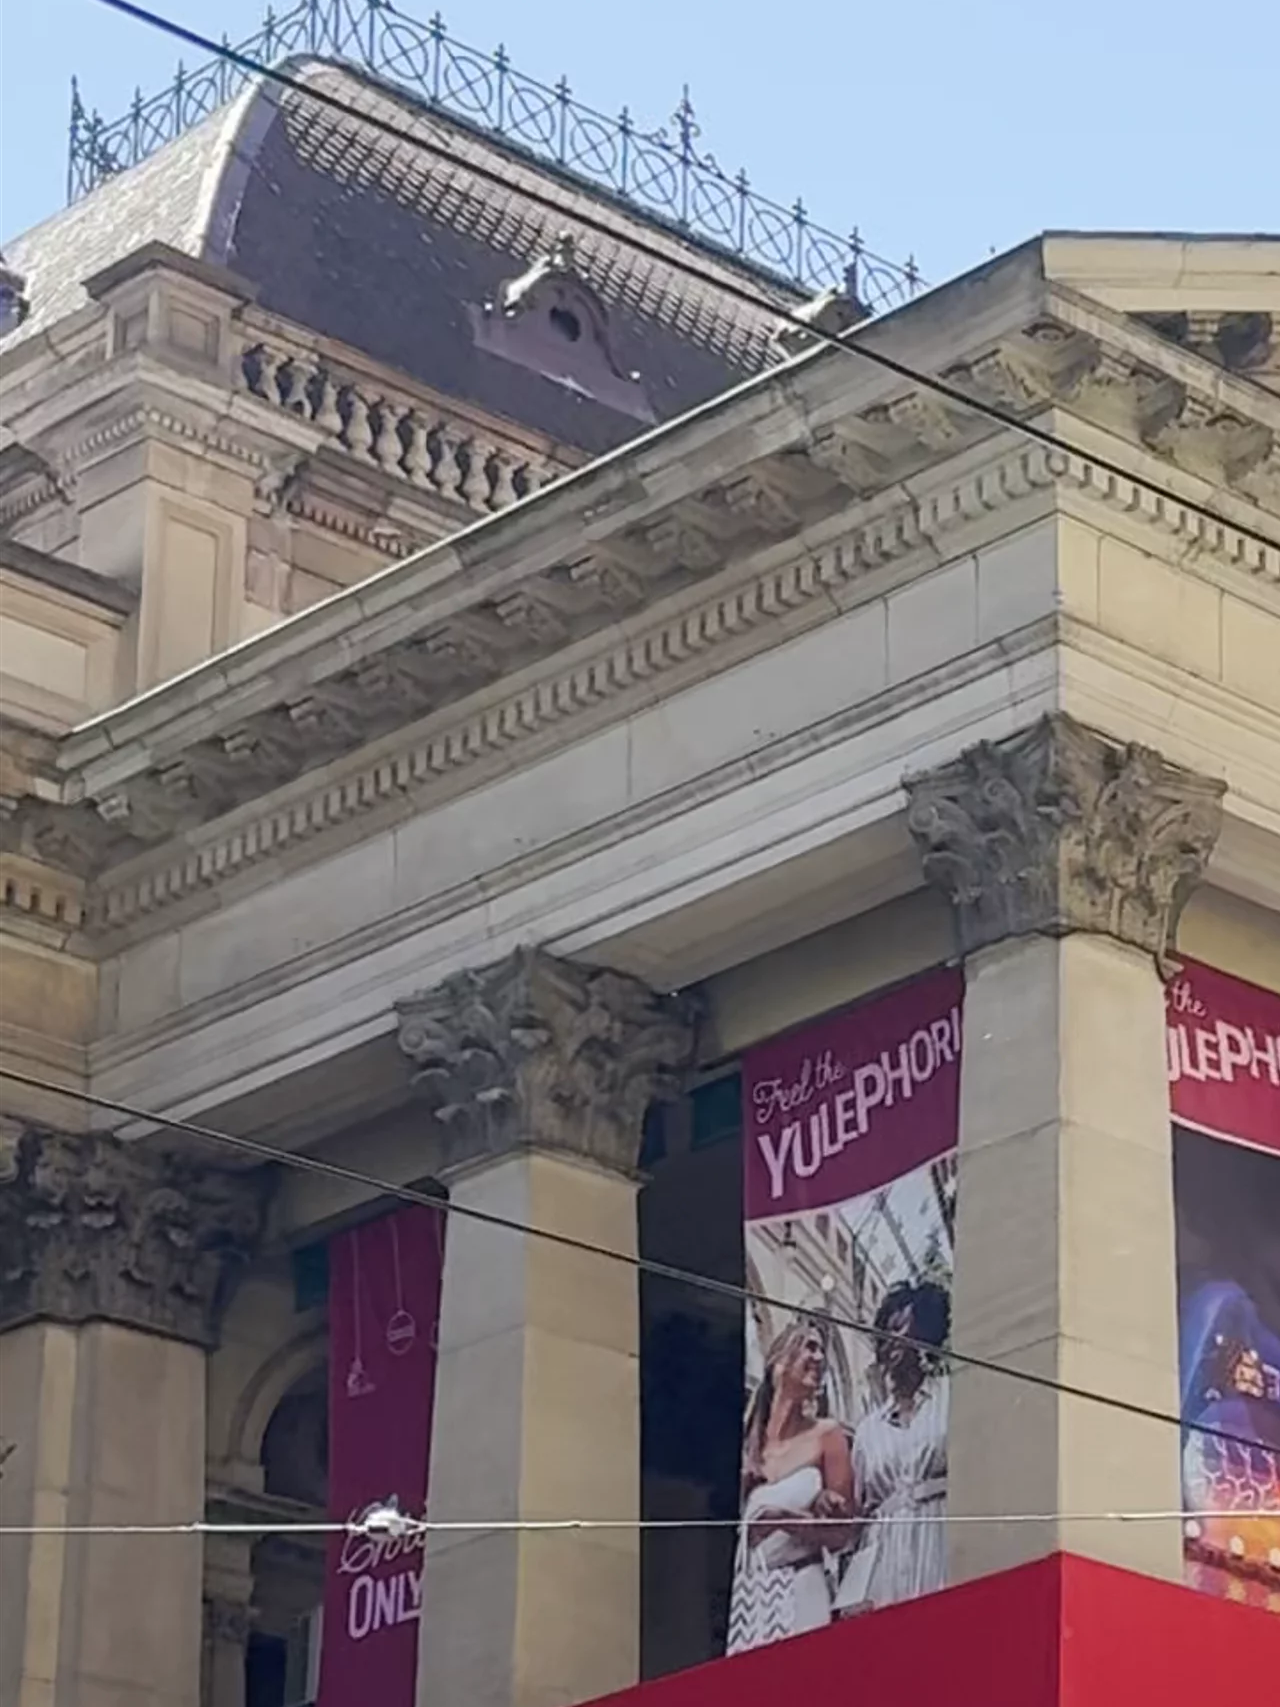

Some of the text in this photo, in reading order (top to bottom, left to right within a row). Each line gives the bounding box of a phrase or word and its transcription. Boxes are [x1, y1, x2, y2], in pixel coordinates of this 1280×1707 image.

[753, 1057, 815, 1125] Feel
[757, 1006, 961, 1200] YULEPHORI
[349, 1570, 423, 1640] ONLY
